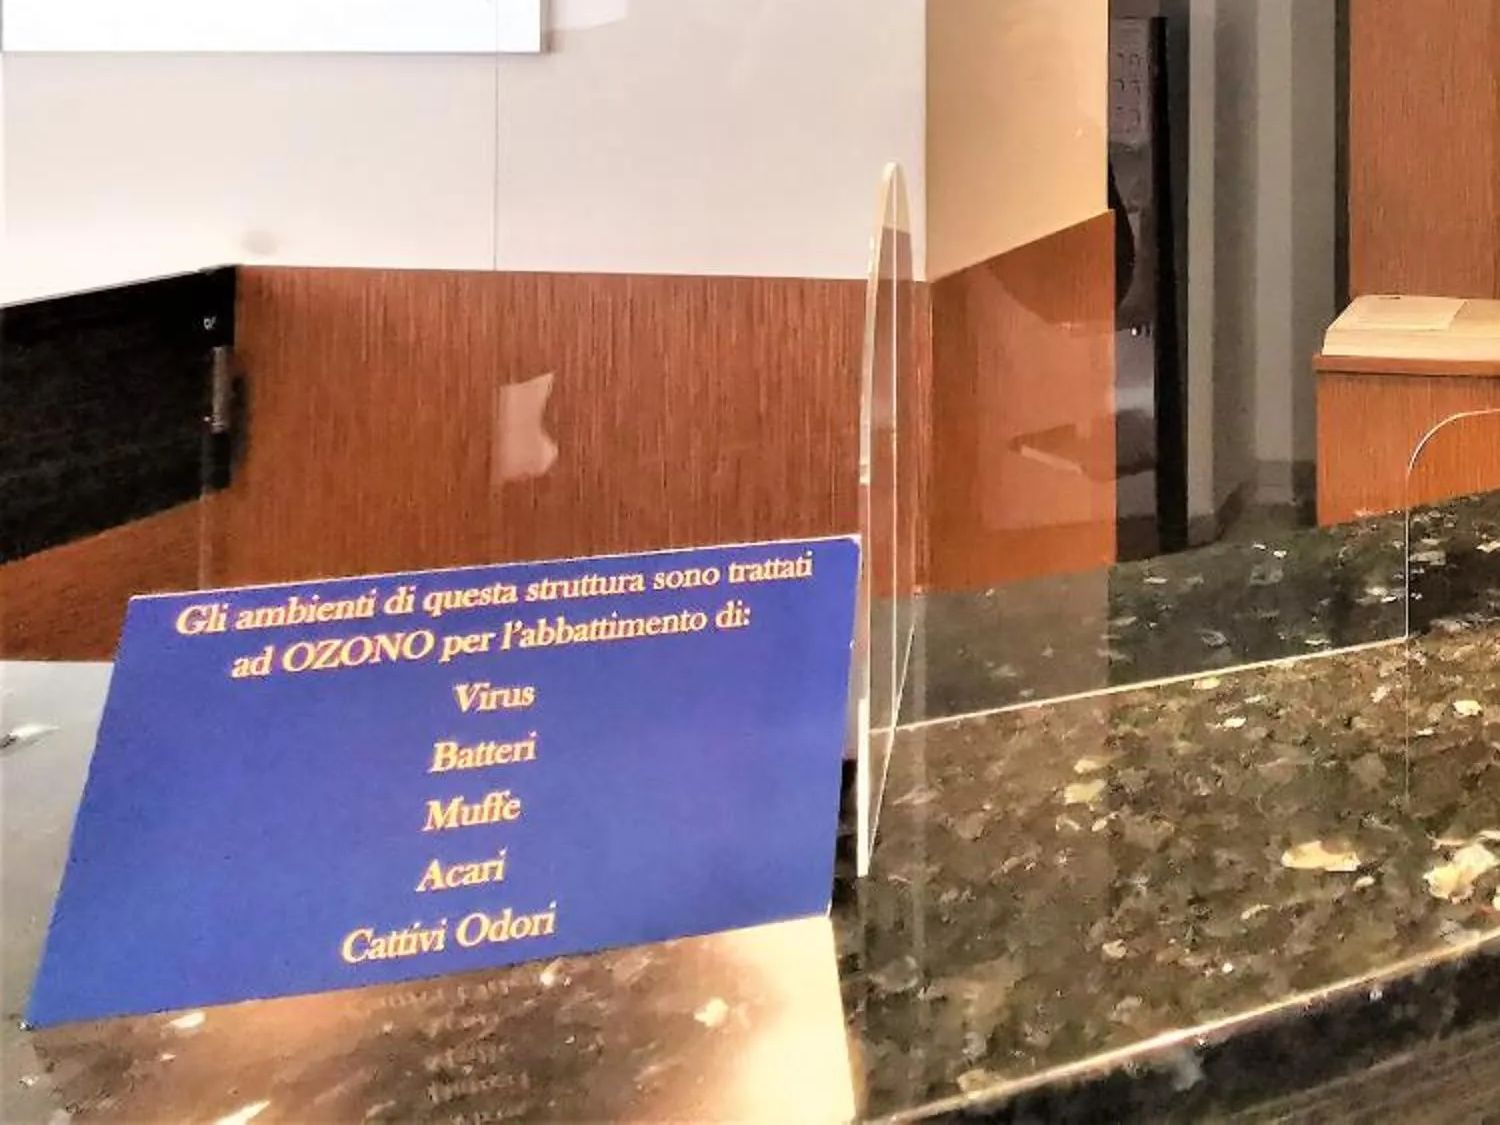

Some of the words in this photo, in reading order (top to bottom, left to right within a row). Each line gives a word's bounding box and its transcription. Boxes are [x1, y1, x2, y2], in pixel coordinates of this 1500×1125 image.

[175, 602, 229, 636] Gli
[235, 588, 376, 630] ambienti
[383, 586, 417, 615] di
[423, 582, 518, 617] questa
[525, 572, 645, 602] struttura
[653, 565, 720, 590] sono
[728, 550, 813, 584] trattati
[231, 644, 274, 678] ad
[282, 630, 435, 672] OZONO
[438, 631, 496, 663] per
[501, 610, 707, 650] l'abbattimento
[715, 599, 751, 628] di:
[453, 681, 536, 712] Virus
[427, 731, 537, 774] Batteri
[421, 789, 521, 832] Muffe
[415, 846, 507, 893] Acari
[341, 918, 447, 963] Cattivi
[456, 901, 556, 948] Odori
